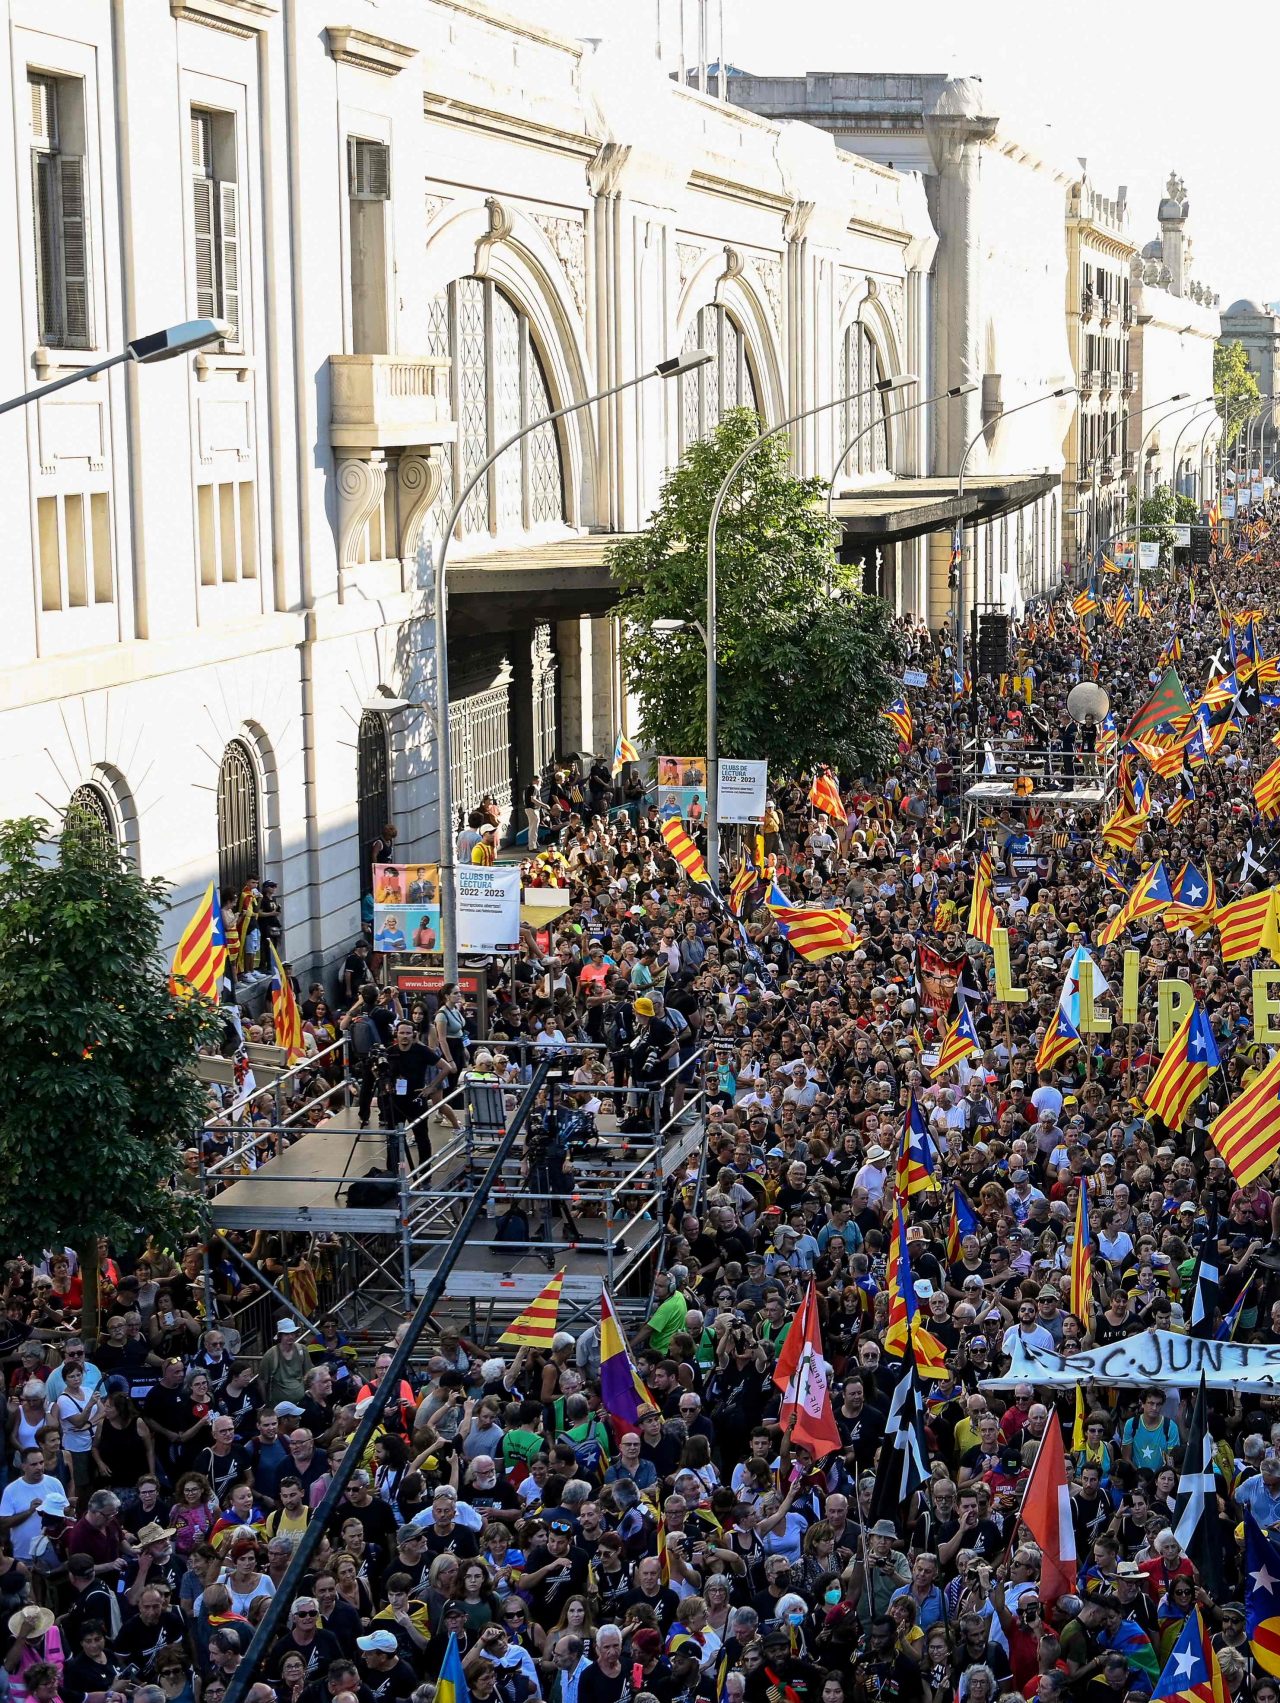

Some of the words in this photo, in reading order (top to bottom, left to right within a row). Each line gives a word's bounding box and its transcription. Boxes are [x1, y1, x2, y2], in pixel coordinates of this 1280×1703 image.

[459, 872, 484, 880] CLUBS
[484, 873, 495, 881] DE
[459, 880, 492, 889] LECTURA
[459, 888, 479, 897] 2022
[484, 889, 505, 898] 2023
[405, 980, 470, 988] www.barcelcat
